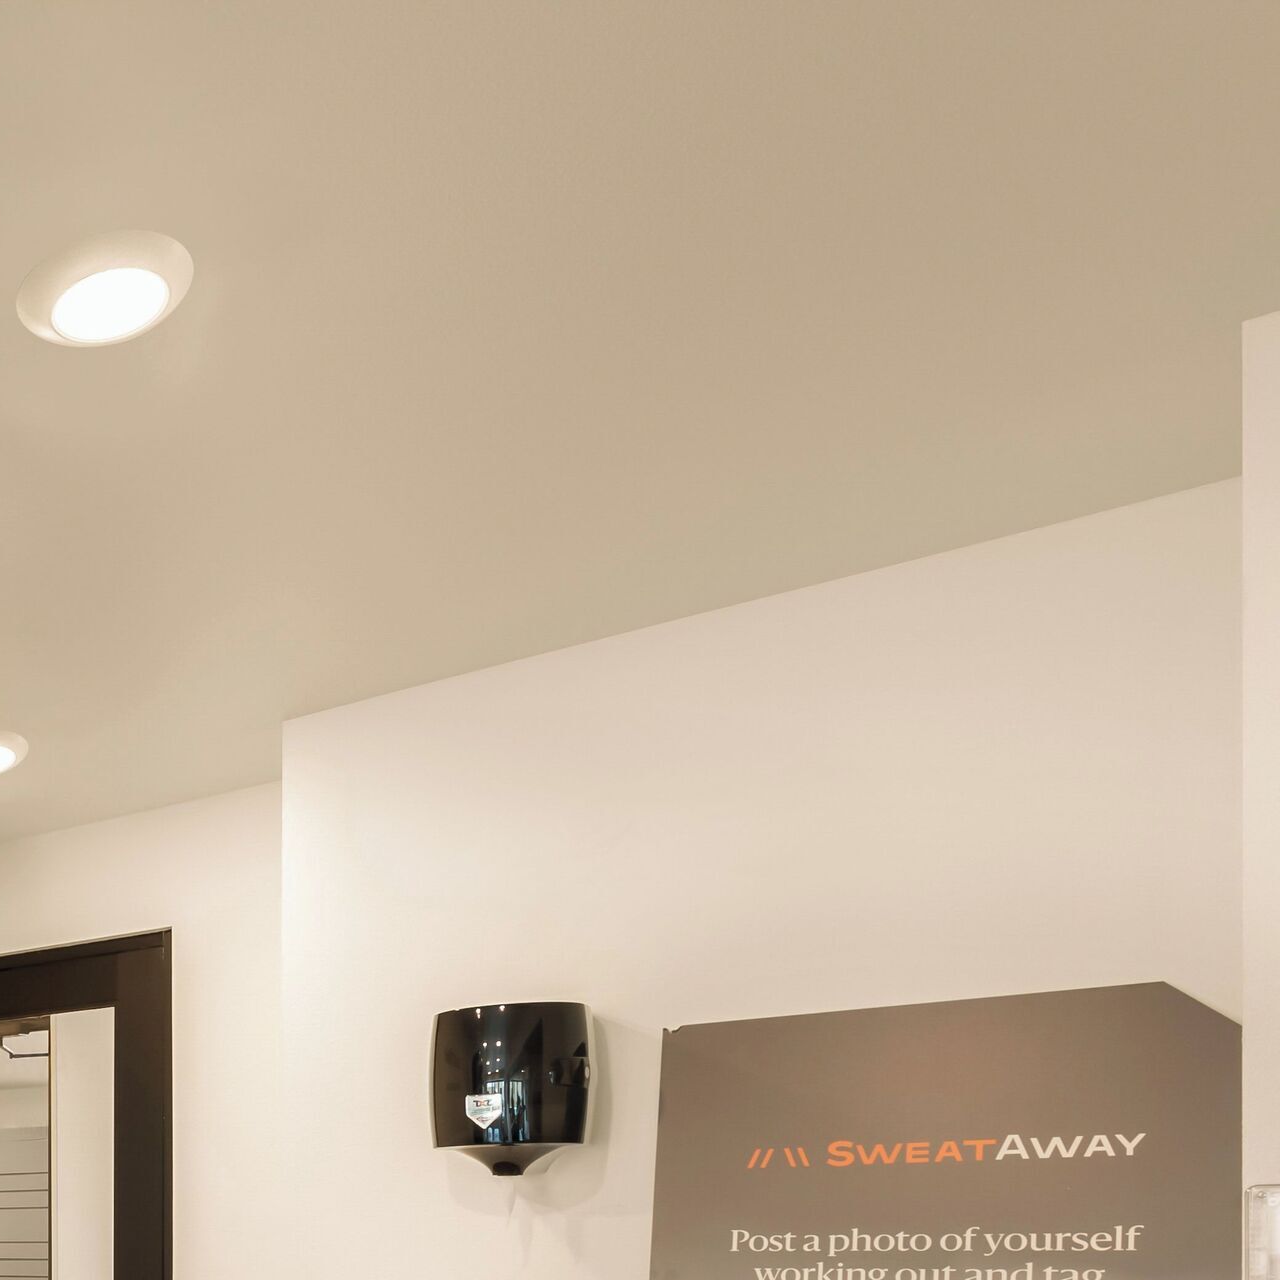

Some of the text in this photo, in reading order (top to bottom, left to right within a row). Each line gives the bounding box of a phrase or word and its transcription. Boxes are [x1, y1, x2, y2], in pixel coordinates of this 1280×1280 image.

[730, 1224, 1144, 1256] Post a photo of yourself
